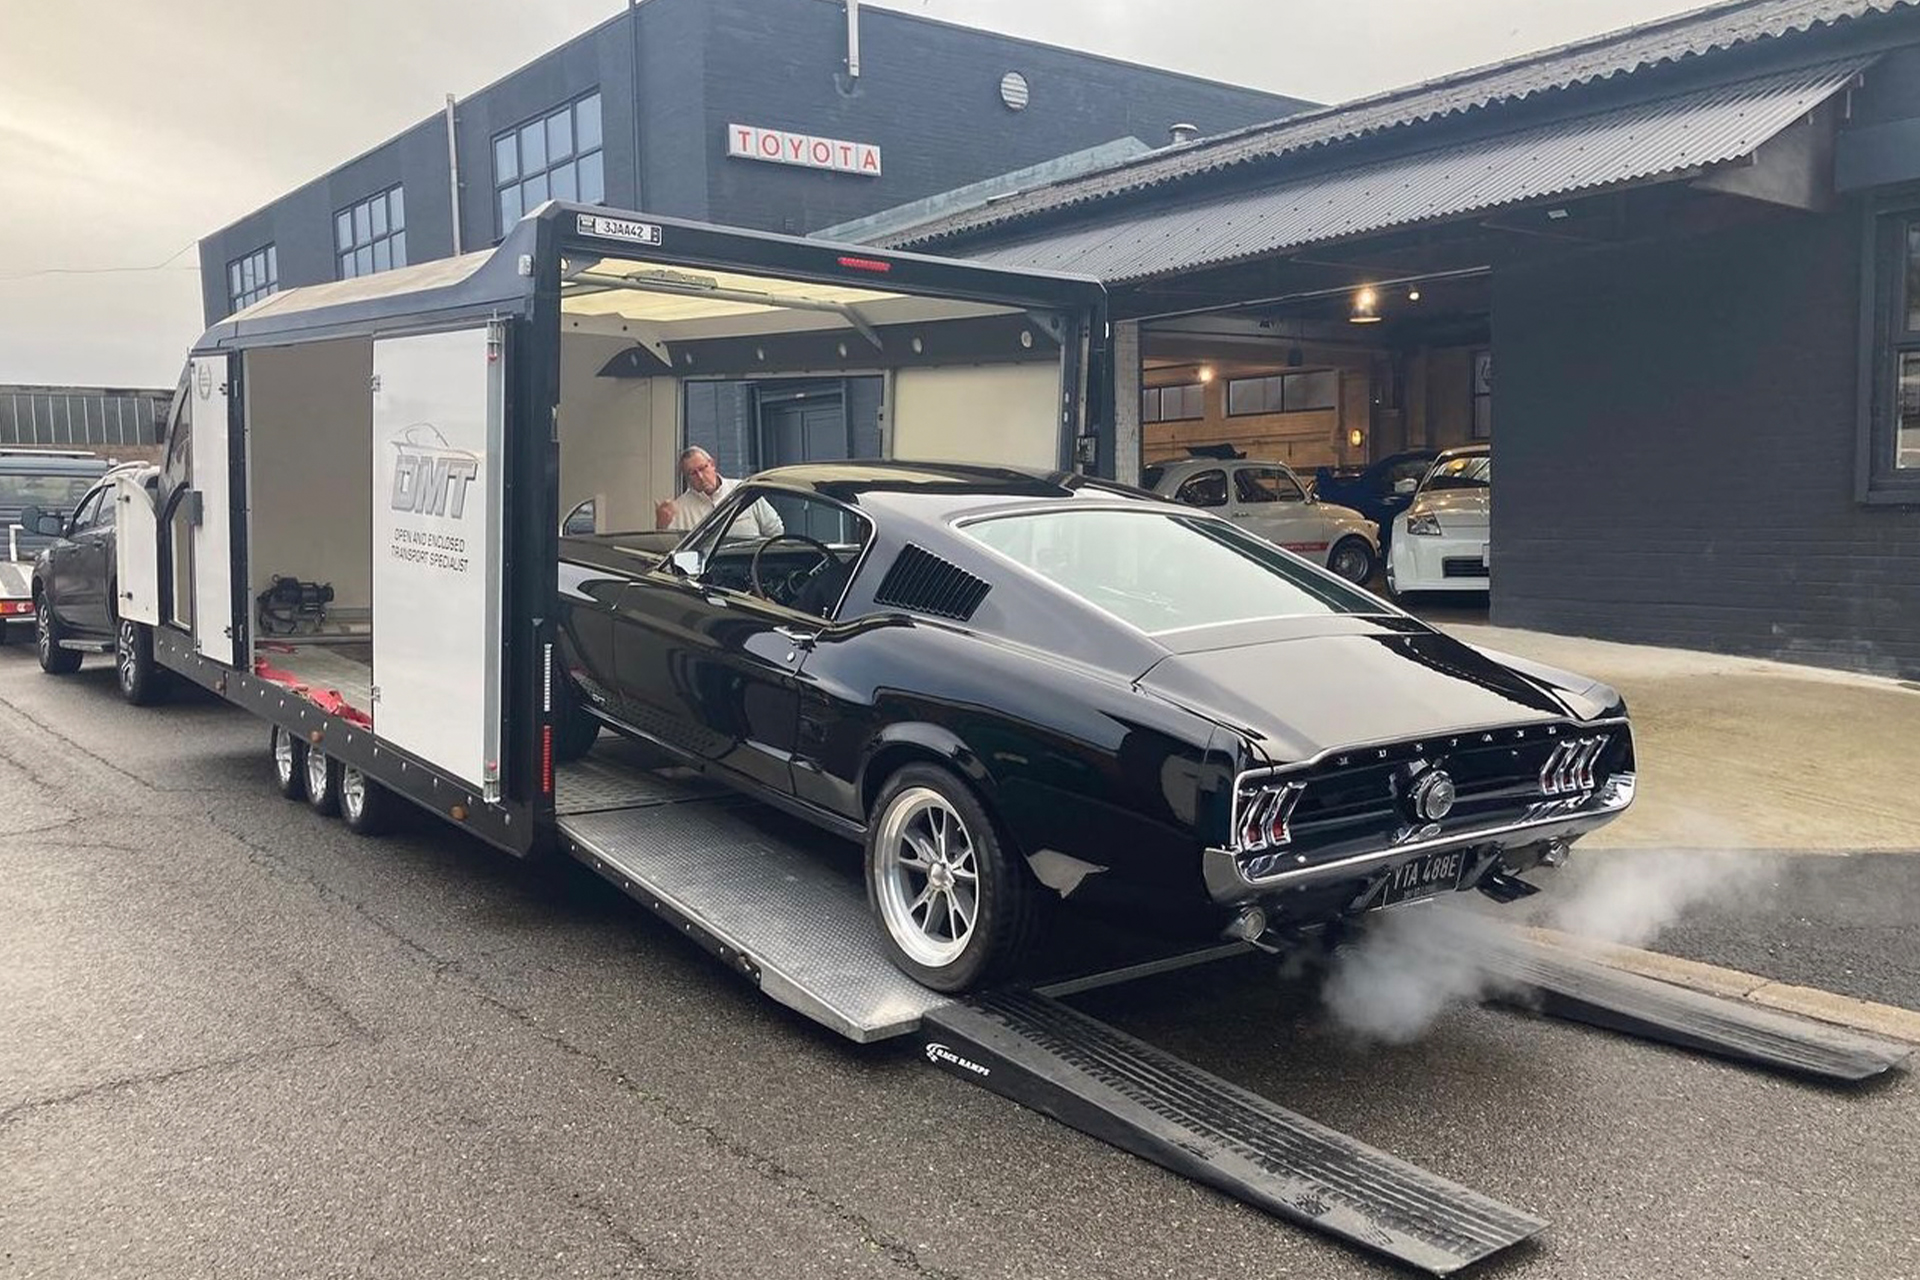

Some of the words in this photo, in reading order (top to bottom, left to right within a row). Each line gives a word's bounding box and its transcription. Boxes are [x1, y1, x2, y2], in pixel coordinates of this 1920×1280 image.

[737, 130, 878, 171] TOYOTA
[394, 528, 411, 543] OPEN
[412, 531, 426, 546] AND
[427, 533, 465, 553] ENCLOSED
[391, 544, 429, 563] TRANSPORT
[429, 552, 469, 572] SPECIALIST
[1393, 862, 1418, 890] YTA
[1422, 854, 1459, 882] 488E
